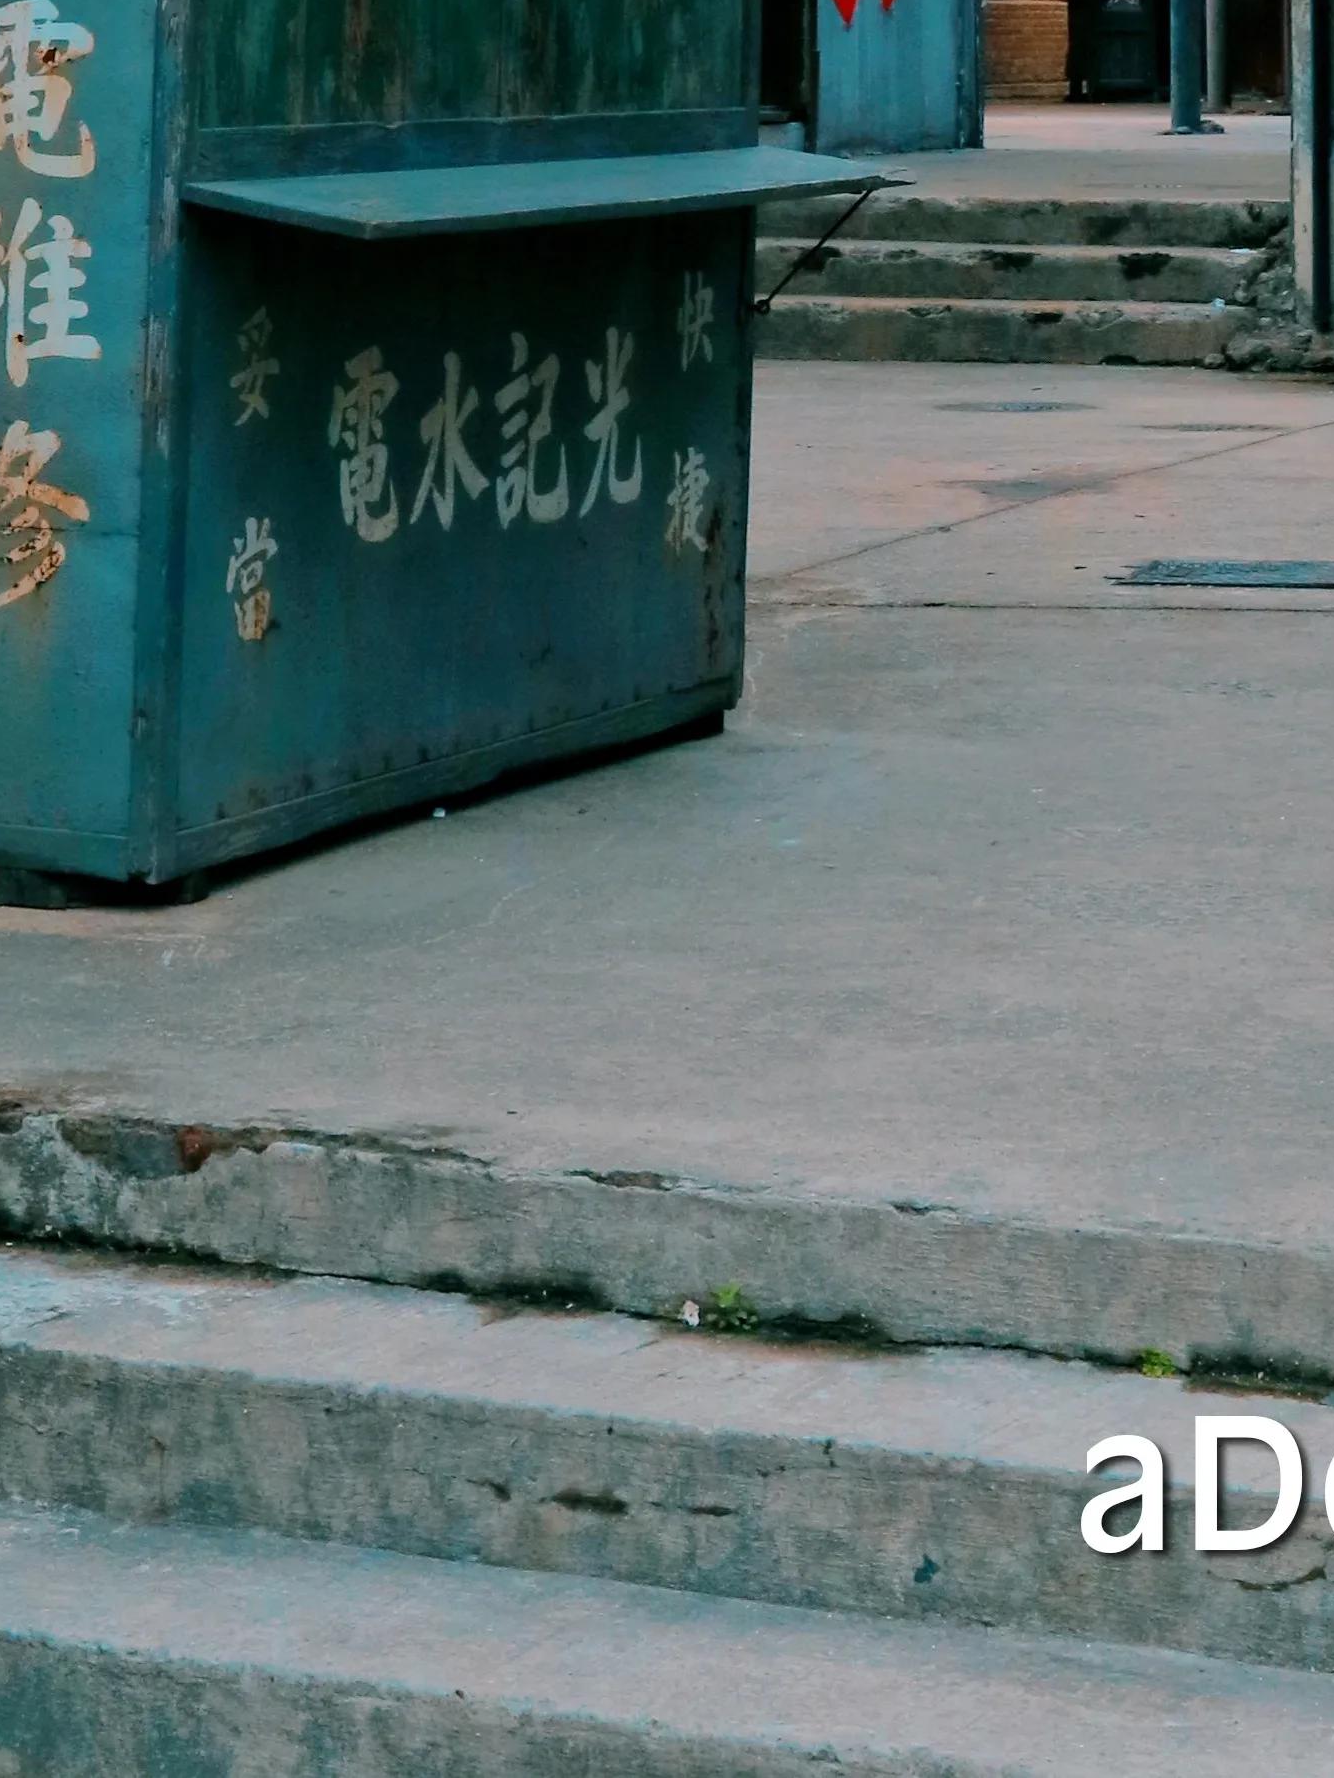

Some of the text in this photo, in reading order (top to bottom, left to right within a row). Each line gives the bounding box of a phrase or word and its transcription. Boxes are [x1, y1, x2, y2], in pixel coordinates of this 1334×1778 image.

[225, 304, 280, 643] 妥當
[327, 325, 643, 544] 光記水電
[664, 270, 715, 555] 快捷
